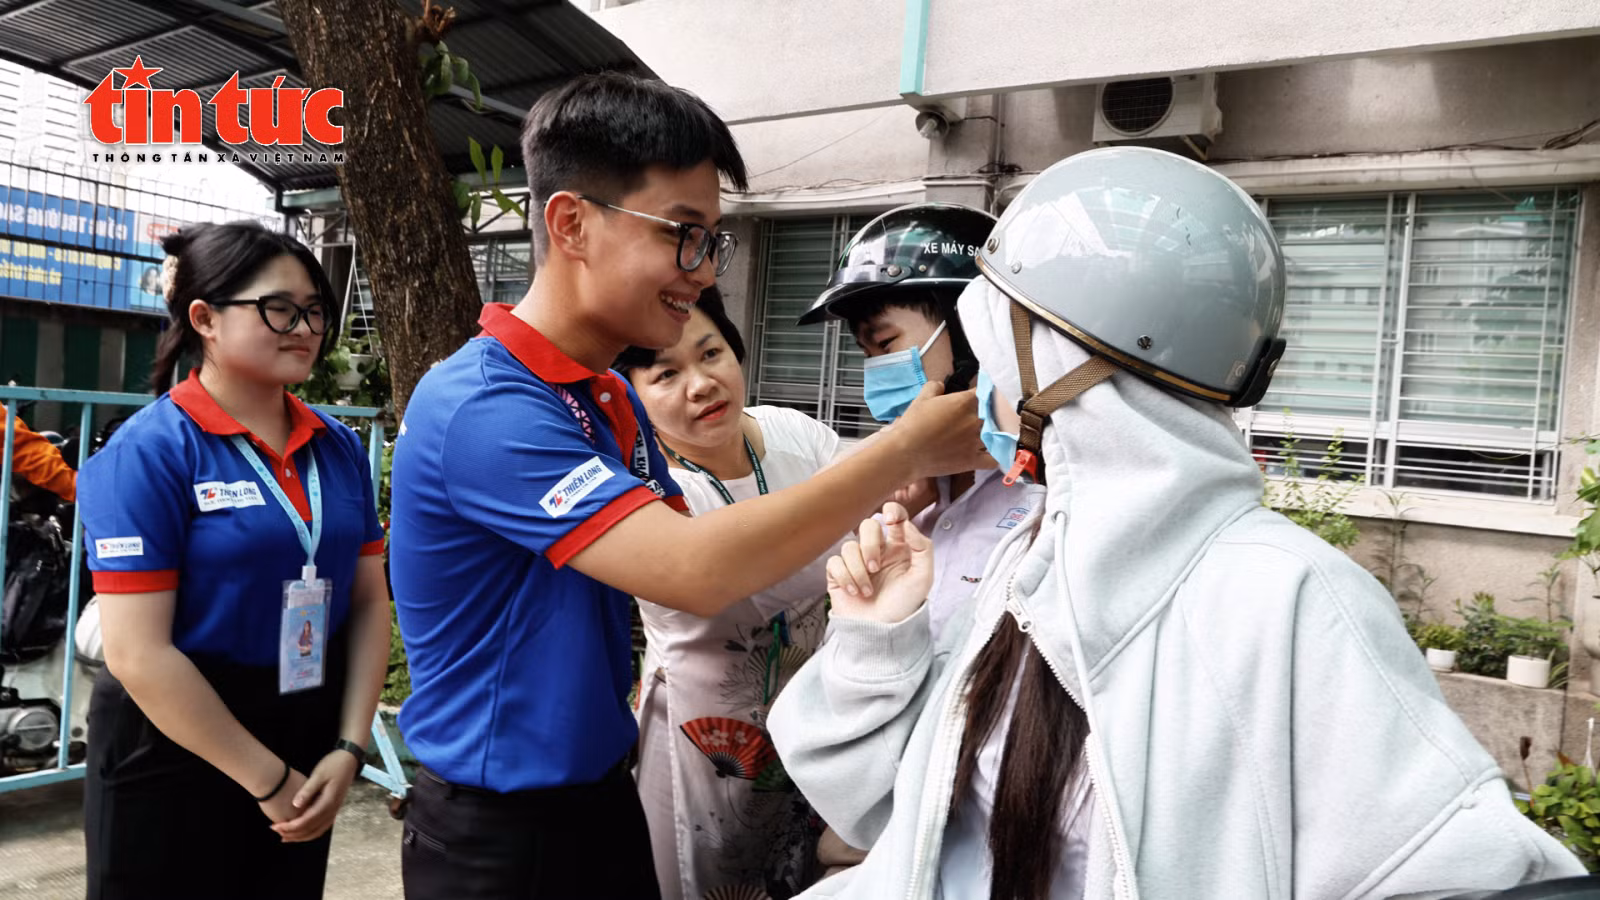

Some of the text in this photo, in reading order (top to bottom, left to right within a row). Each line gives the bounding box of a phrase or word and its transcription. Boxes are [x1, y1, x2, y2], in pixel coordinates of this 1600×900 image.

[923, 243, 938, 255] XE
[941, 240, 965, 256] MÁY
[563, 474, 585, 497] THIÊN
[583, 465, 602, 481] LONG
